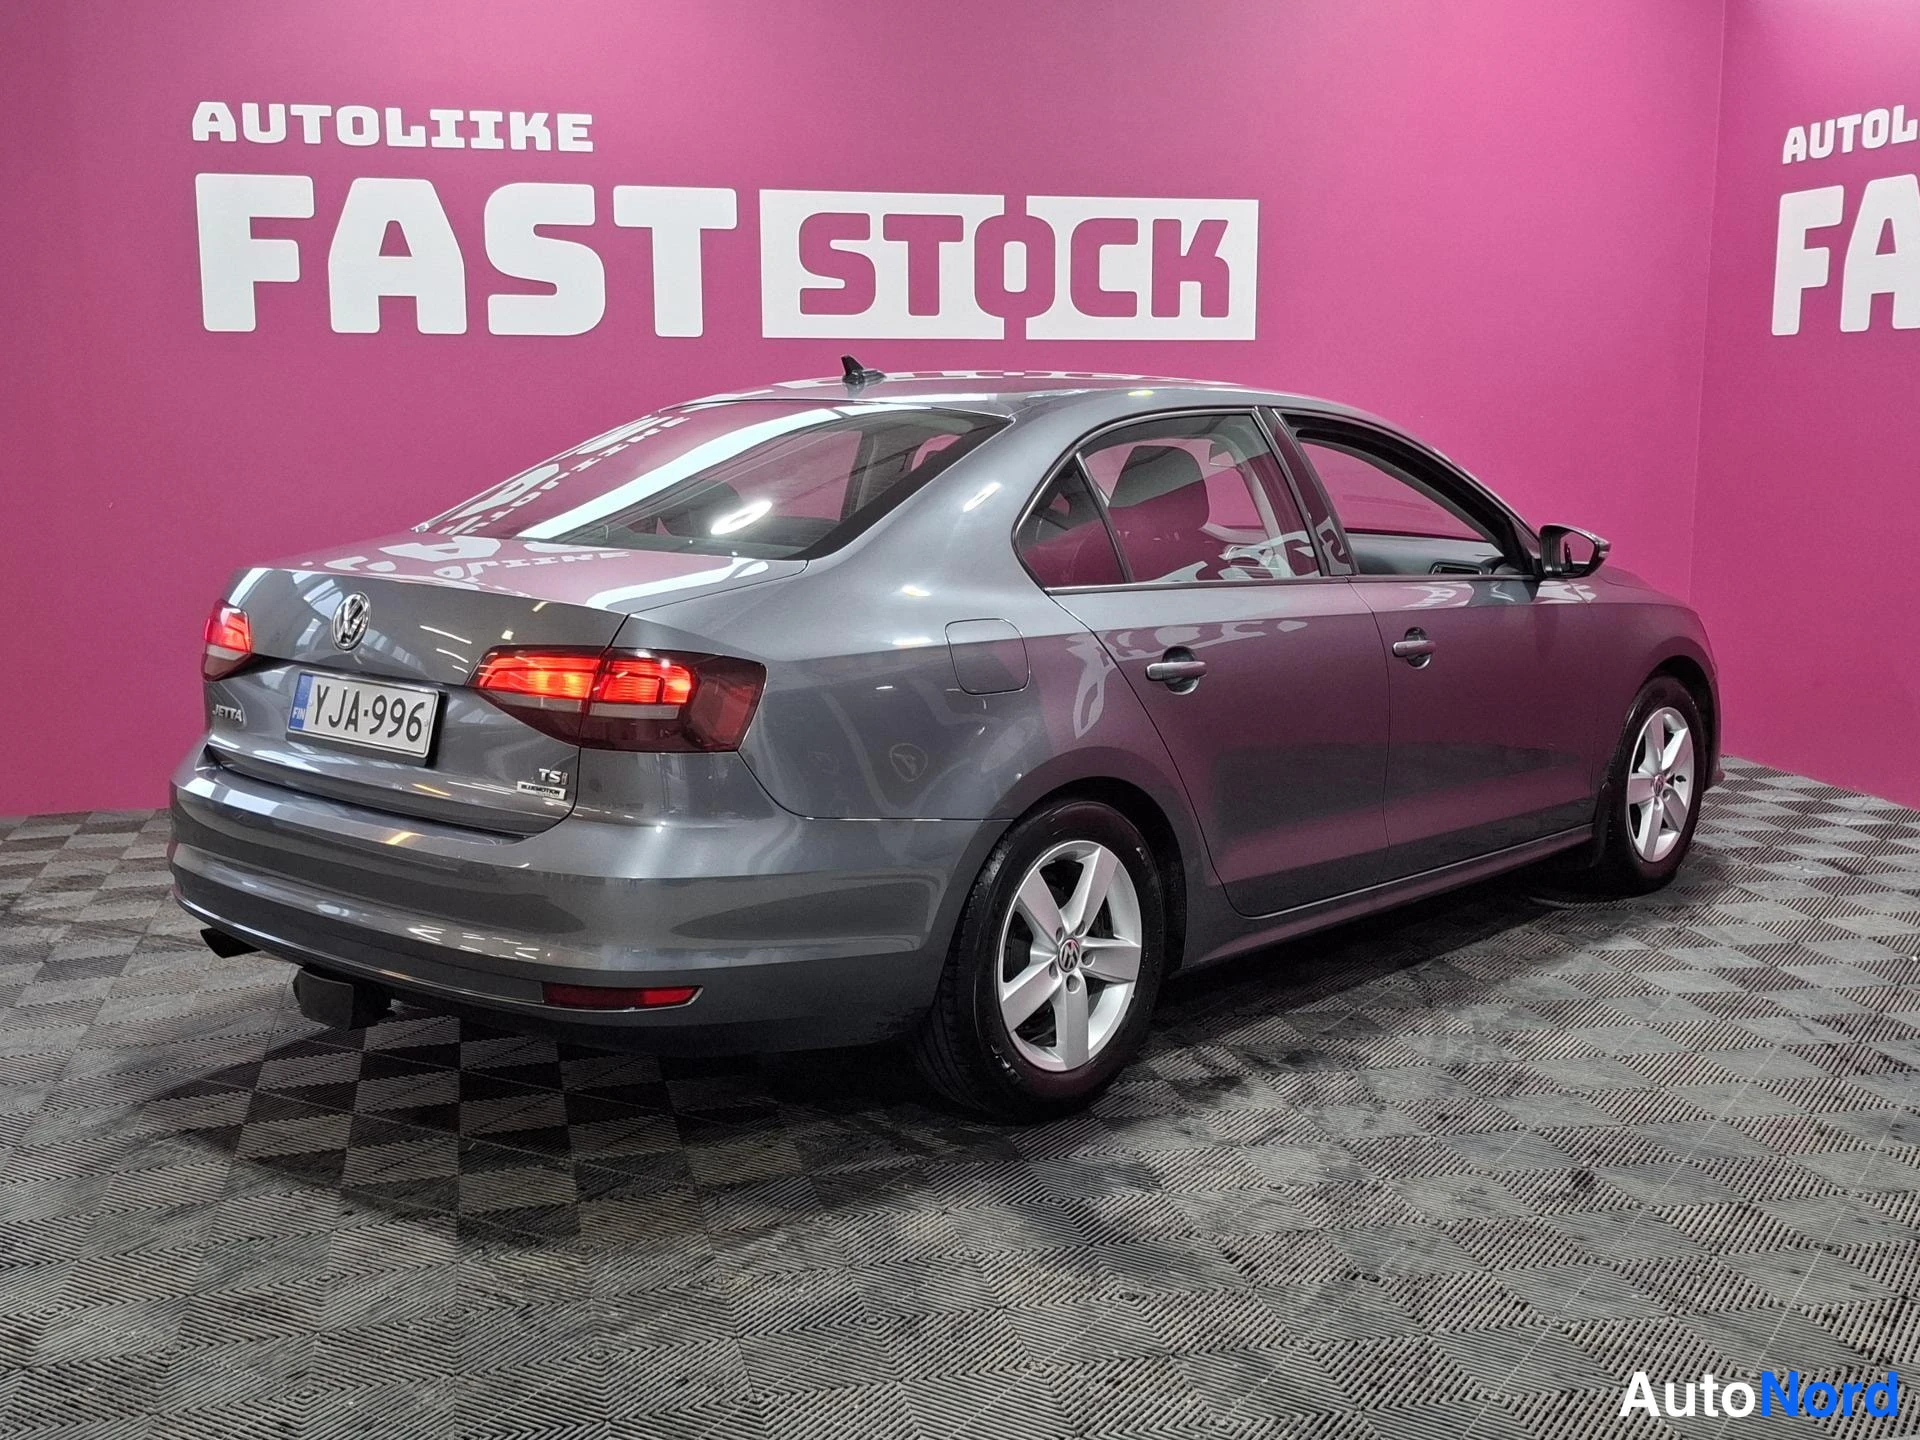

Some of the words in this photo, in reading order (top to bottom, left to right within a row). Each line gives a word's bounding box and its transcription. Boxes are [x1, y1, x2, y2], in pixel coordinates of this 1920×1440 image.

[192, 101, 594, 153] AUTOLIIKE
[195, 173, 738, 338] FAST
[797, 211, 1231, 319] STOCK
[1771, 173, 1920, 336] FA
[212, 703, 243, 722] JETTA
[292, 707, 306, 721] FIN
[314, 684, 426, 743] YJA-996
